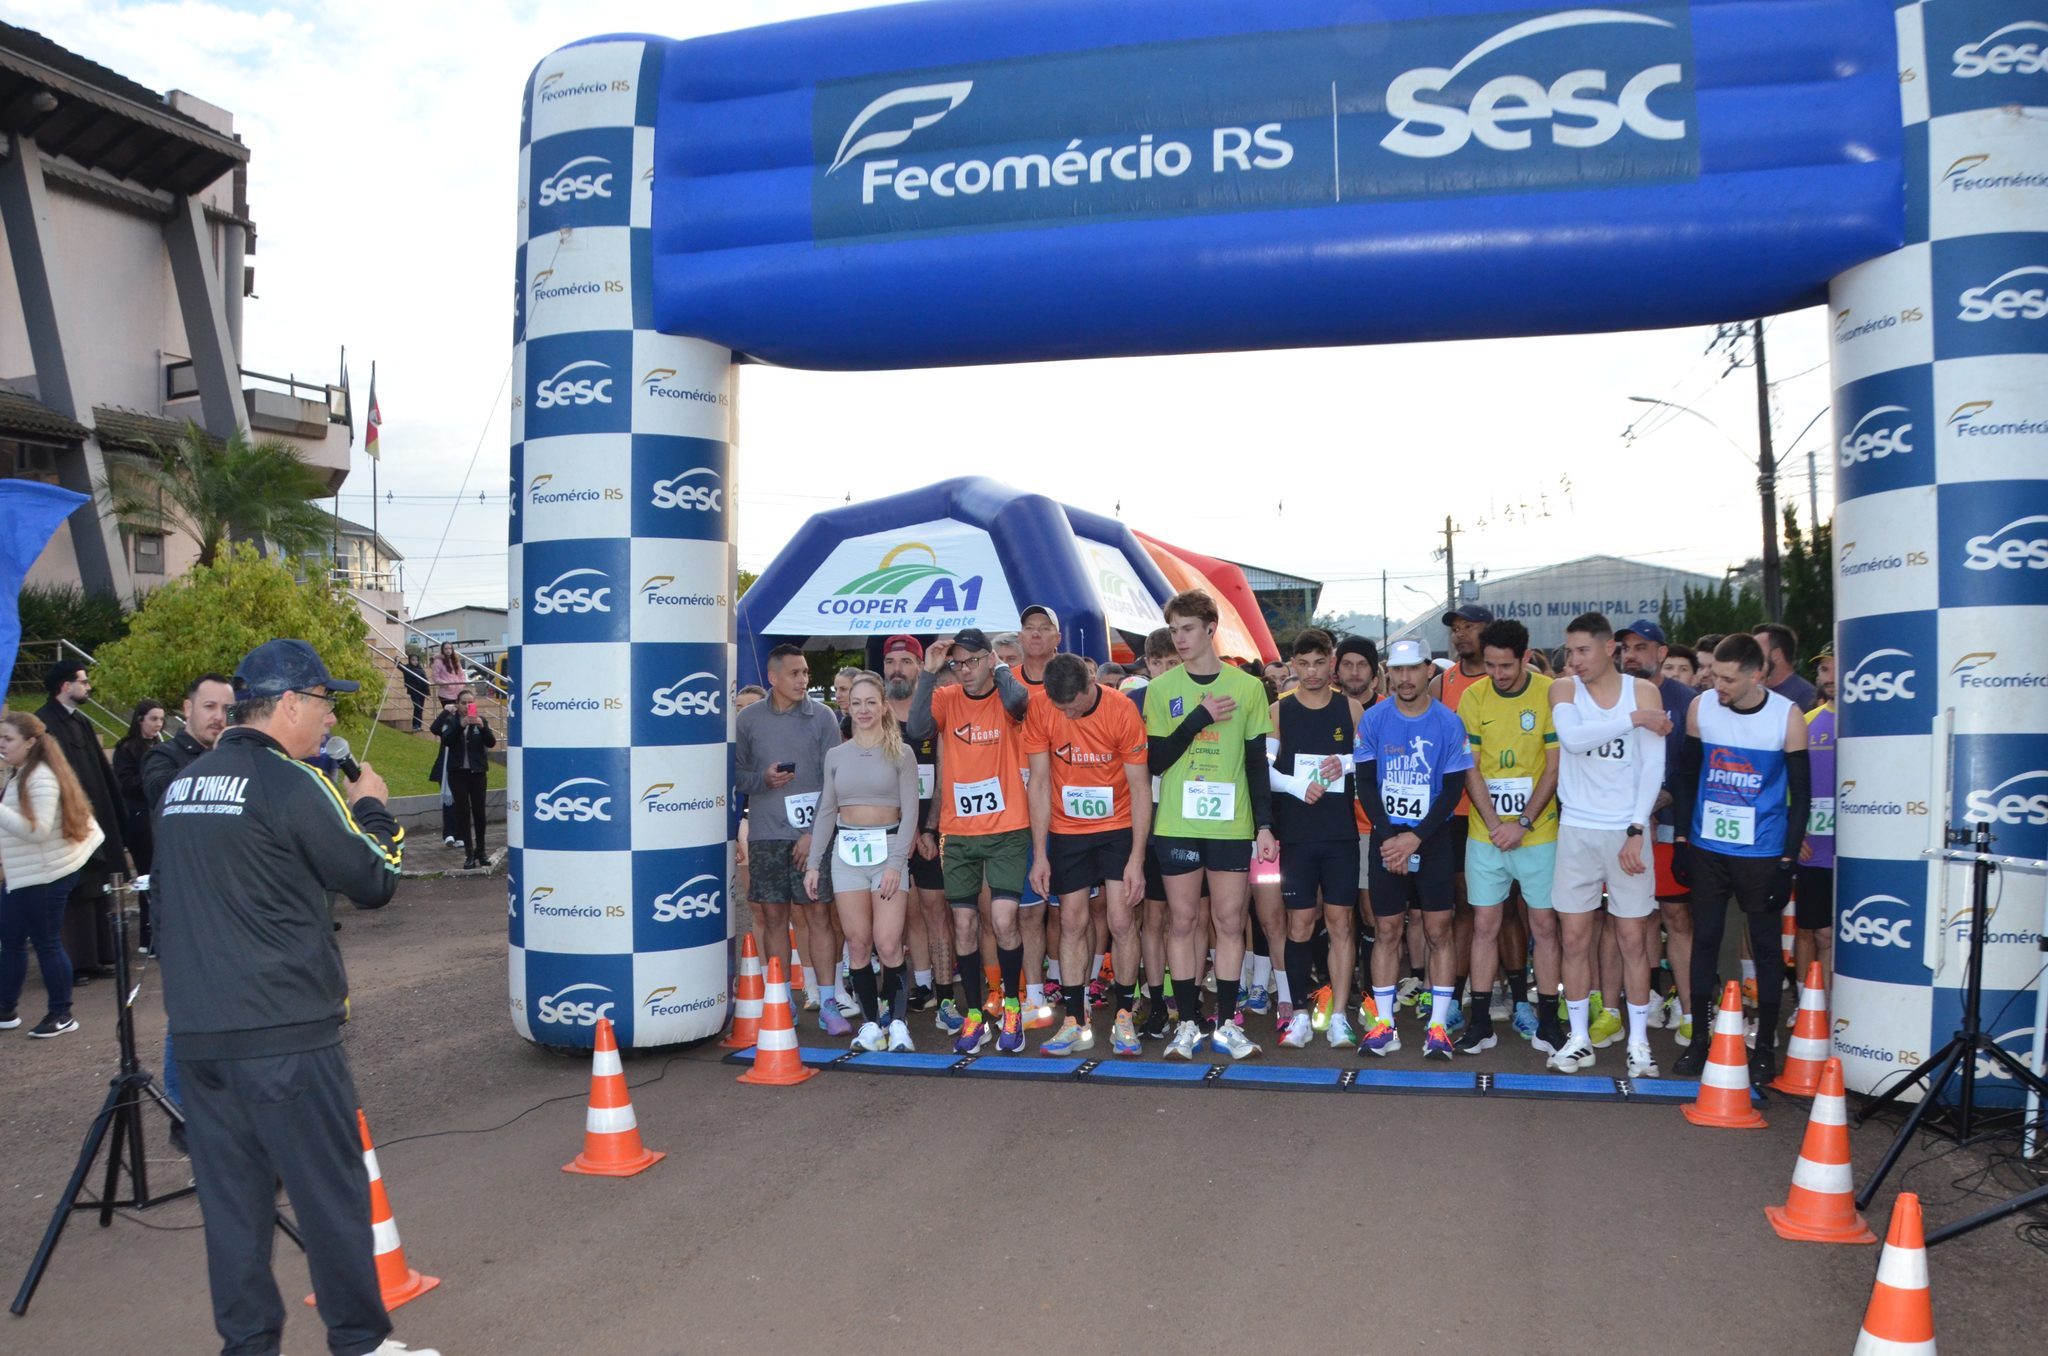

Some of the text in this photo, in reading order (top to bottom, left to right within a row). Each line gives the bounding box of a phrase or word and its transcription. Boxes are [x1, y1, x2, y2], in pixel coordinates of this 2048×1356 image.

[541, 80, 630, 103] Fecomércio RS
[862, 122, 1294, 205] Fecomércio RS
[535, 280, 624, 301] Fecomércio RS
[1957, 287, 2048, 322] Ses
[1901, 307, 1923, 324] RS
[649, 384, 717, 404] Fecomércio
[1957, 420, 2048, 437] Fecomérci
[533, 489, 600, 504] Fecomércio
[604, 488, 624, 500] RS
[1906, 552, 1929, 567] RS
[1963, 535, 2048, 571] Ses
[648, 592, 715, 606] Fecomércio
[817, 575, 983, 615] COOPER A1
[1490, 600, 1542, 617] INÁSIO
[1547, 600, 1633, 616] MUNICIPAL
[1639, 599, 1661, 614] 29
[849, 615, 975, 631] faz parte da gente
[1960, 673, 2048, 688] Fecomérc
[531, 698, 623, 711] Fecomércio RS
[1586, 738, 1625, 759] 03
[1500, 749, 1515, 769] 10
[1707, 768, 1763, 789] JAIME
[192, 775, 249, 803] PINHAL
[648, 798, 714, 813] Fecomércio
[960, 791, 998, 814] 973
[1070, 799, 1107, 817] 160
[1196, 796, 1221, 817] 62
[1386, 795, 1422, 818] 854
[1490, 793, 1526, 813] 708
[1840, 801, 1928, 816] Fecomércio RS
[1964, 790, 2048, 824] Ses
[1715, 818, 1740, 840] 85
[851, 844, 872, 862] 11
[534, 903, 625, 918] Fecomércio RS
[652, 1000, 715, 1016] Fecomércio
[1898, 1051, 1920, 1065] RS
